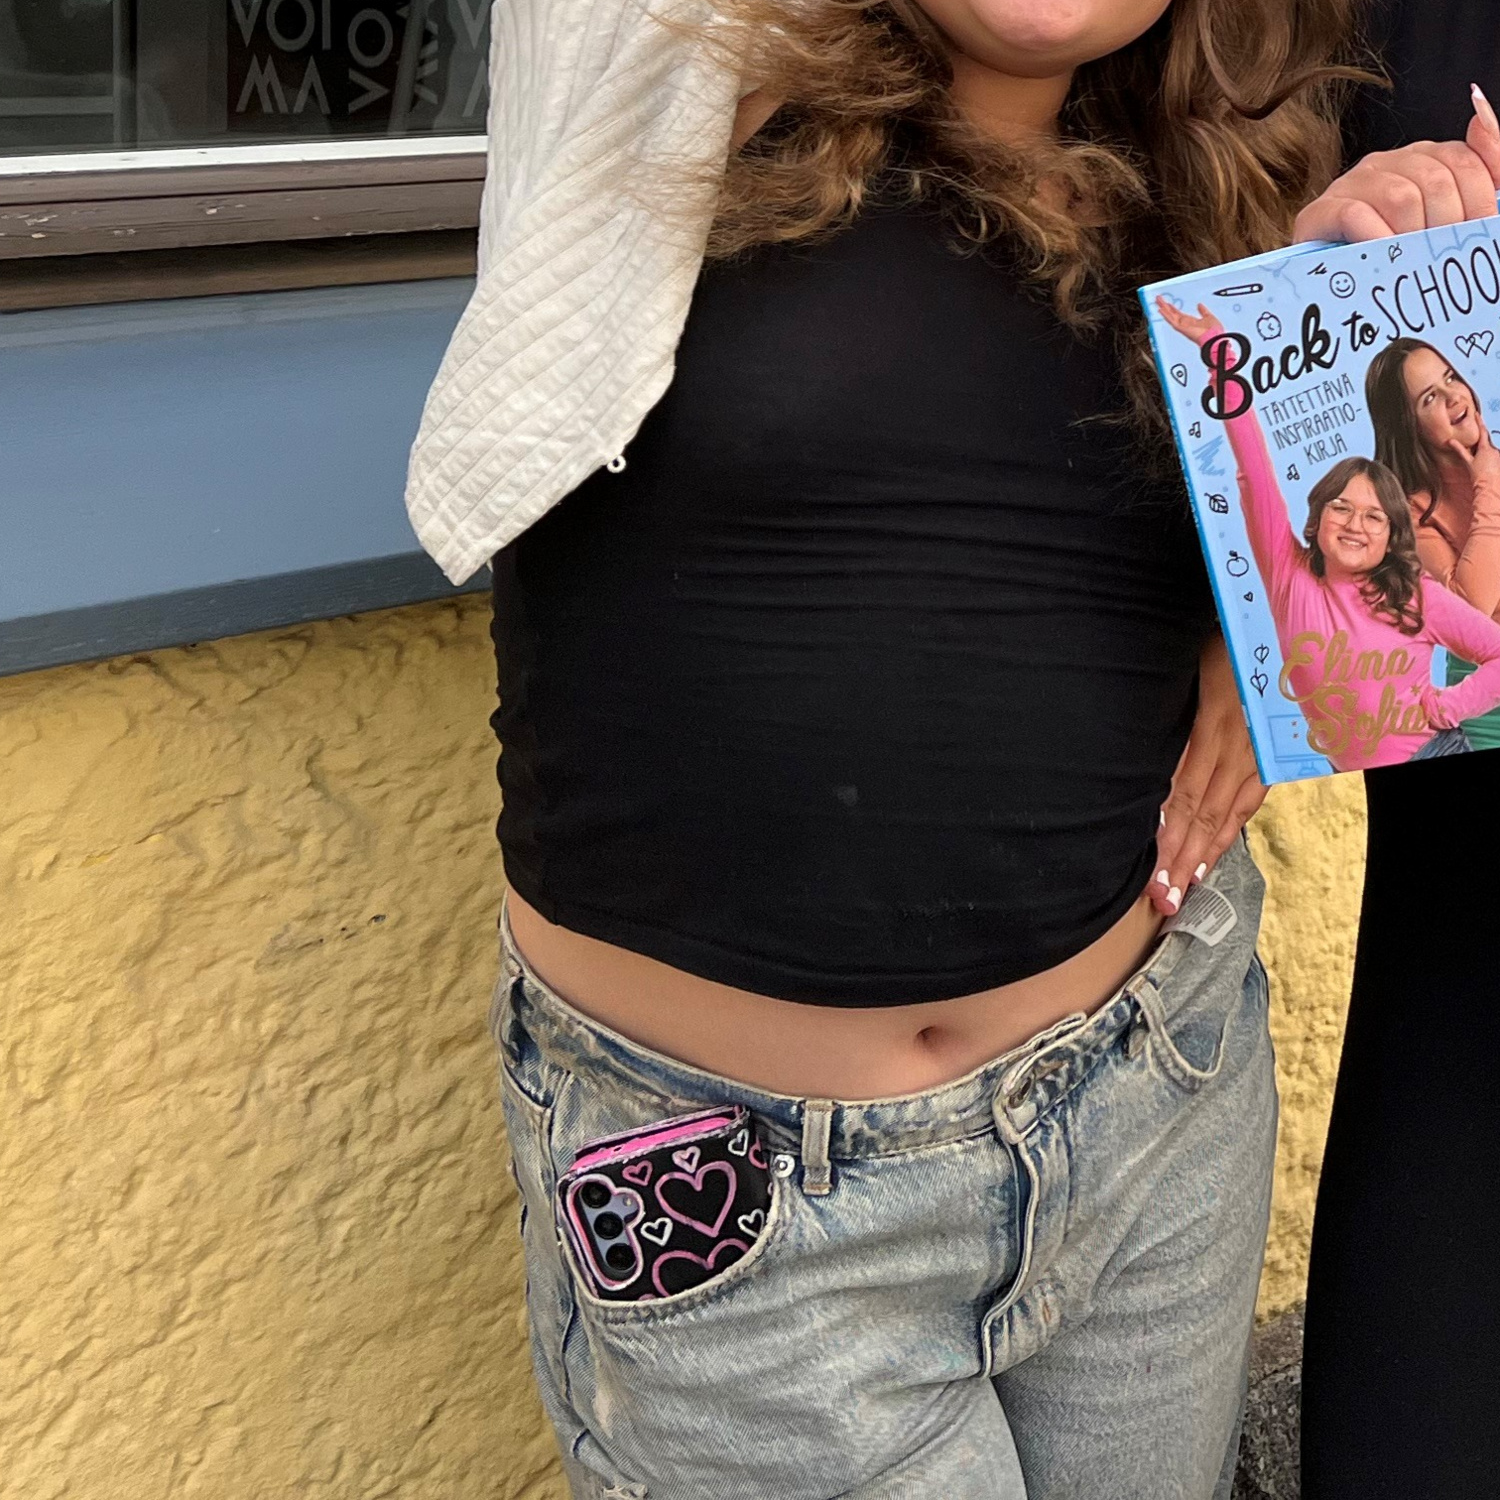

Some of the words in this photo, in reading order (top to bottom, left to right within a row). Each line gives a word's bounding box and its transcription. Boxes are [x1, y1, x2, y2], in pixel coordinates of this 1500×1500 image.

[1200, 303, 1340, 420] Back
[1341, 310, 1380, 352] to
[1260, 373, 1355, 426] TÄYTETTÄVÄ
[1272, 402, 1362, 451] INSPIRAATIO-
[1303, 432, 1348, 465] KIRJA
[1279, 630, 1416, 703] Elina
[1306, 683, 1430, 758] Sofia
